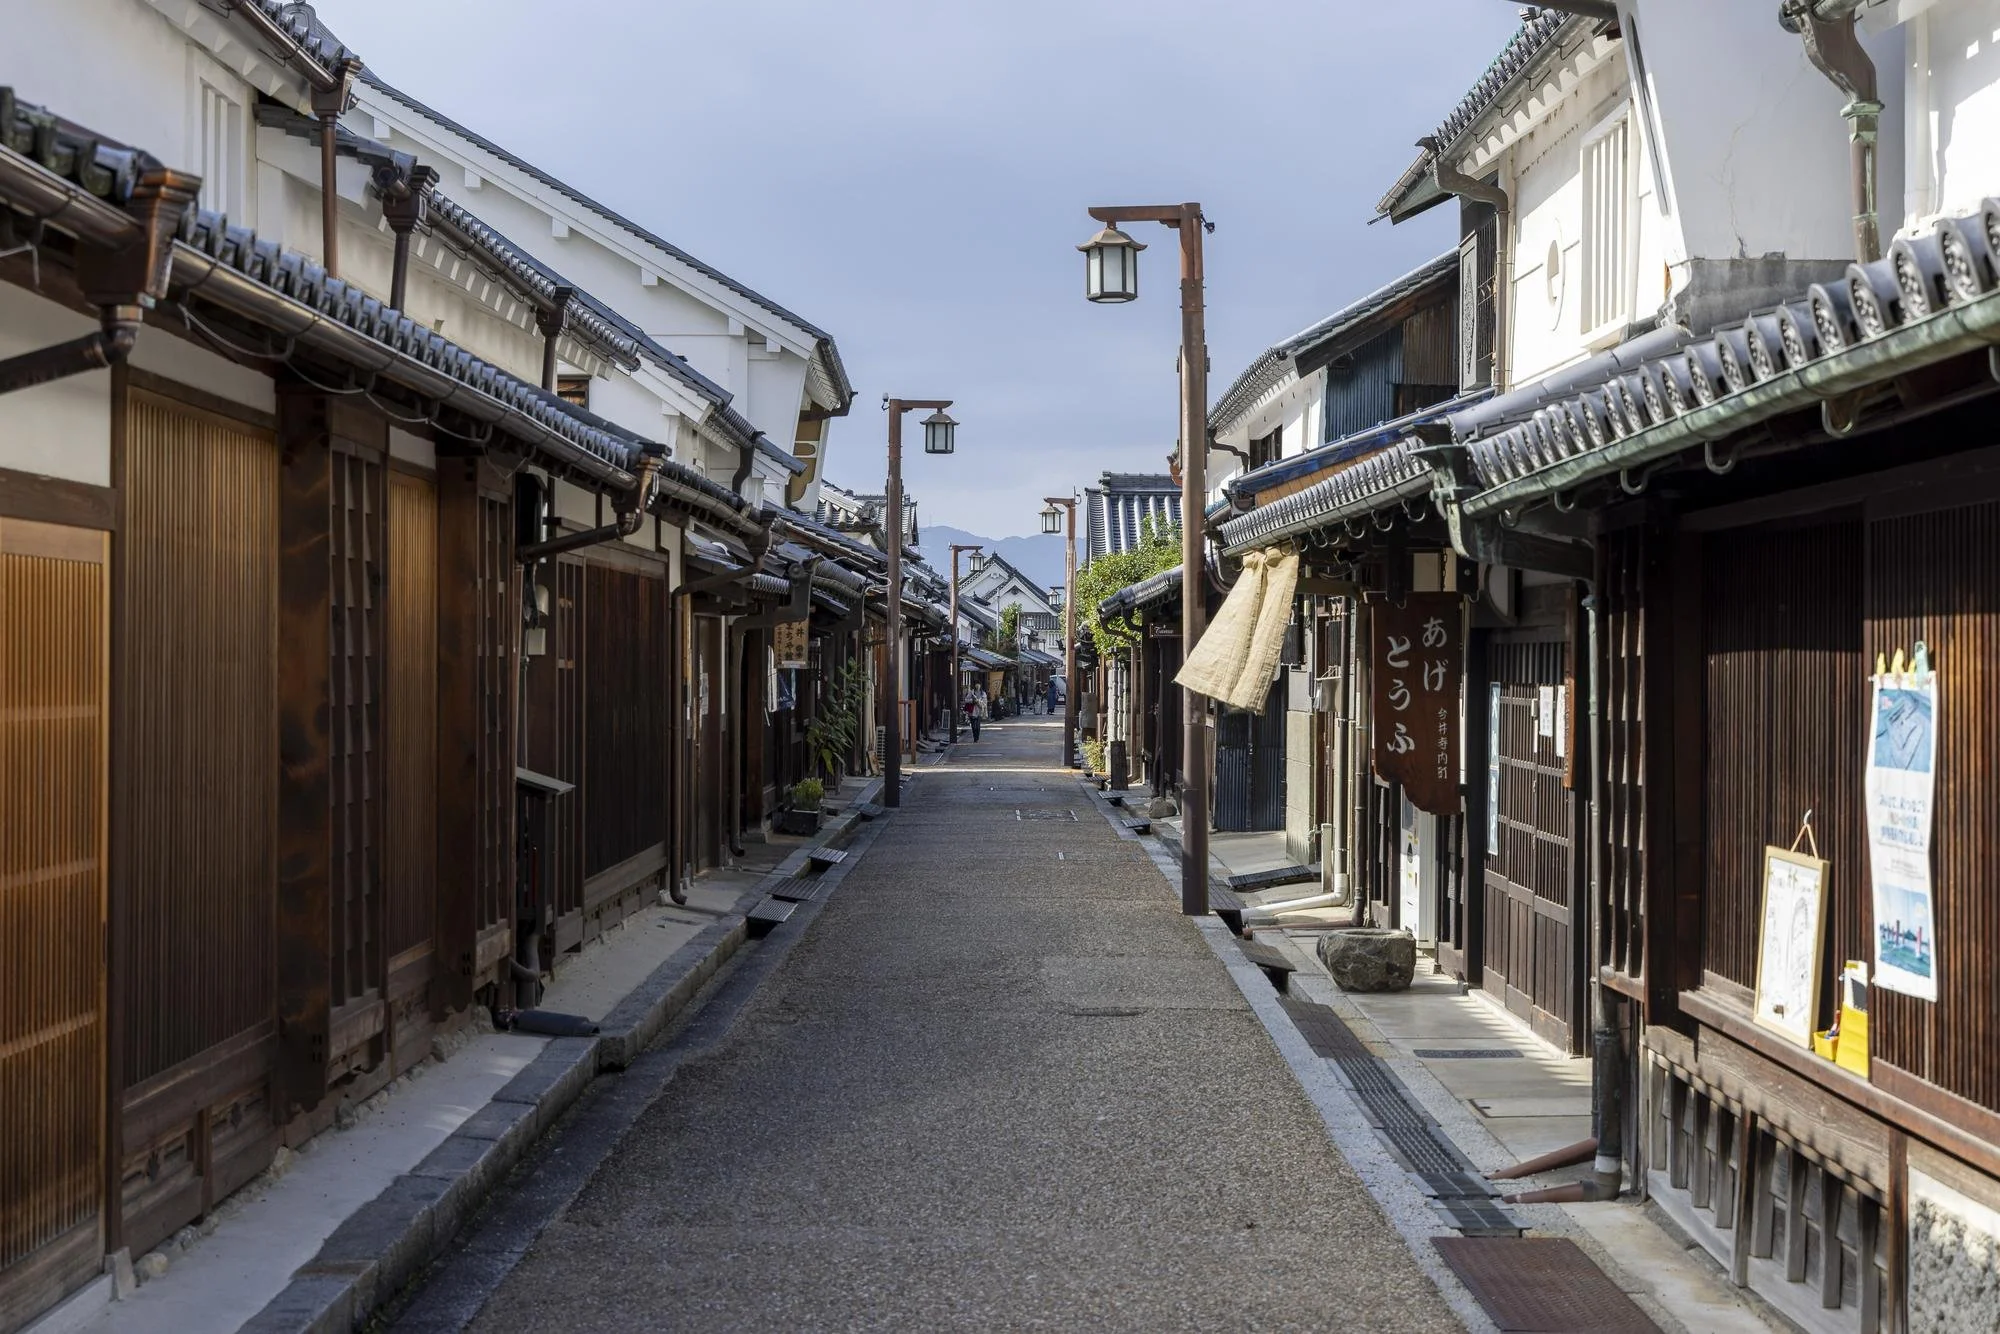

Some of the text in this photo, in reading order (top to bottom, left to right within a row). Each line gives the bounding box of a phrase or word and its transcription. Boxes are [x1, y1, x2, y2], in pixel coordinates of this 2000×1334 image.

[1423, 616, 1449, 692] あげ
[1387, 636, 1416, 755] とうふ
[1437, 707, 1449, 780] 今井寺内町
